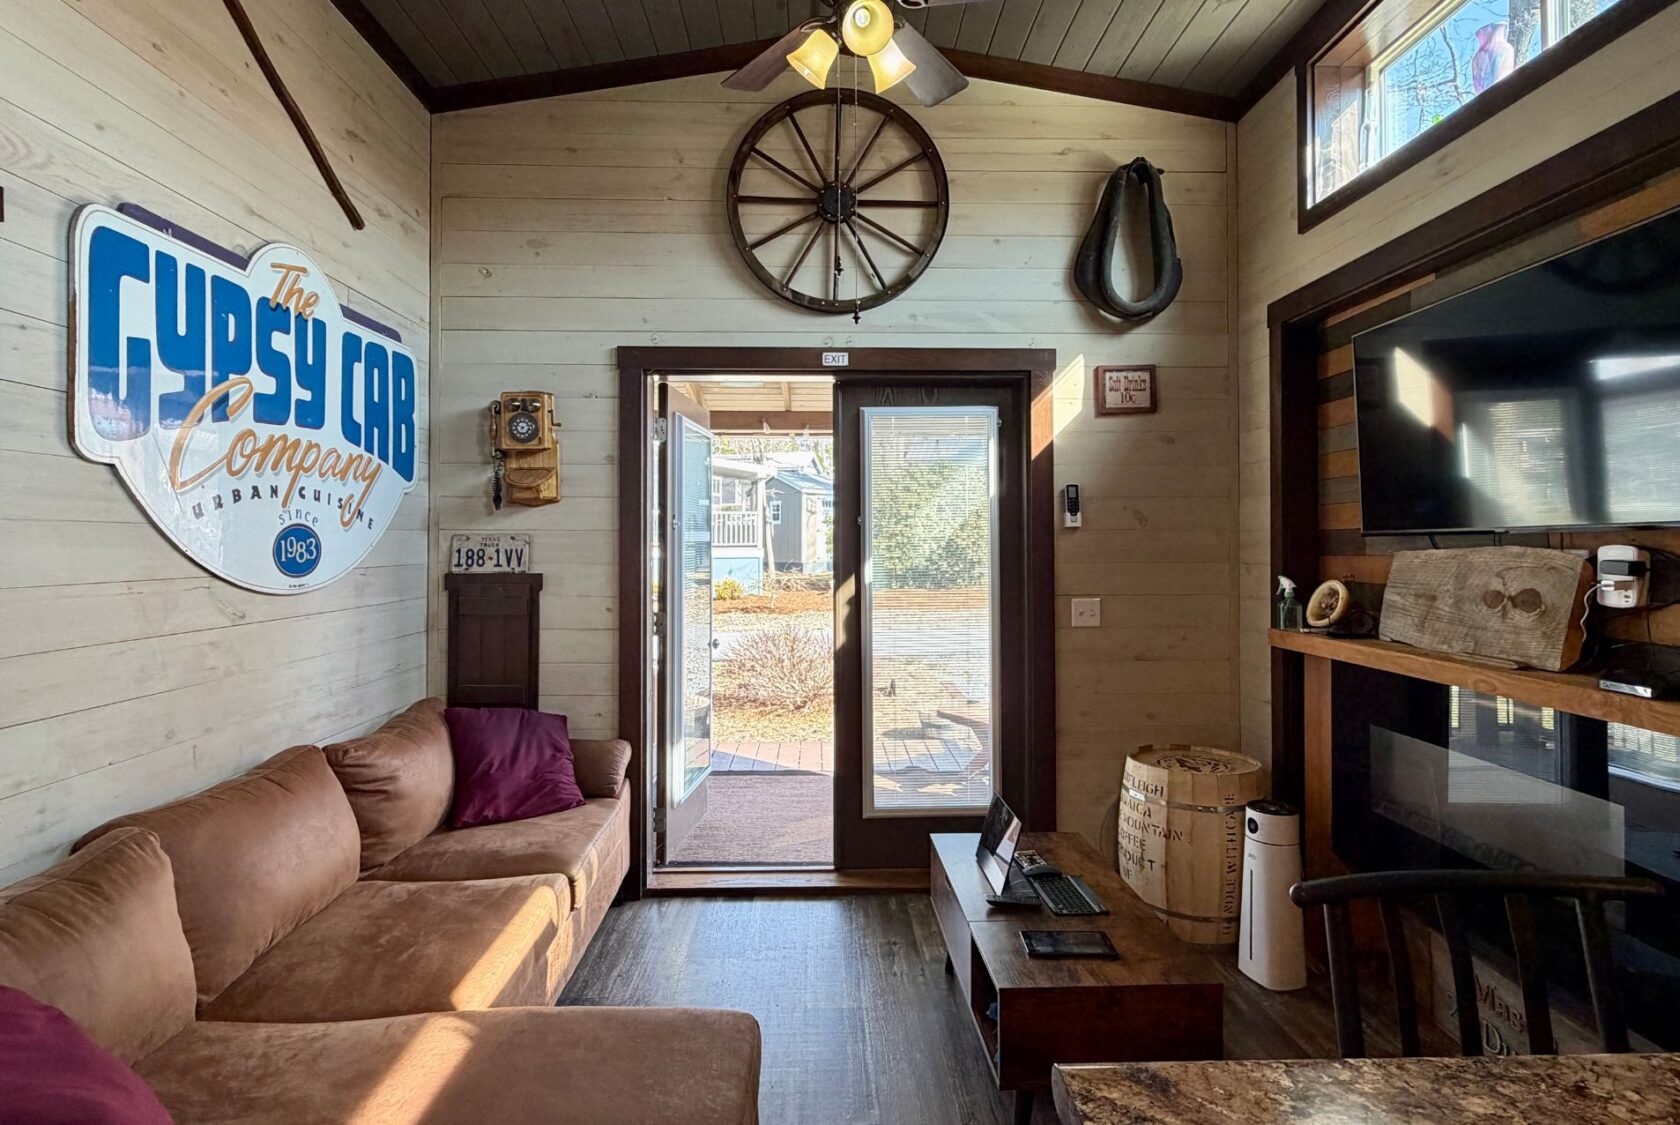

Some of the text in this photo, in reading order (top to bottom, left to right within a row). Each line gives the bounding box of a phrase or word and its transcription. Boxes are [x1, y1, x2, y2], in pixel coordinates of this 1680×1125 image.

[270, 262, 320, 319] The
[88, 225, 416, 483] GYPSY CAB
[823, 354, 847, 364] EXIT
[168, 377, 383, 528] Company
[191, 485, 375, 530] URBAN CUISINE
[278, 505, 319, 527] since
[280, 536, 317, 563] 1983
[453, 548, 486, 567] 188
[1224, 832, 1237, 874] WITH
